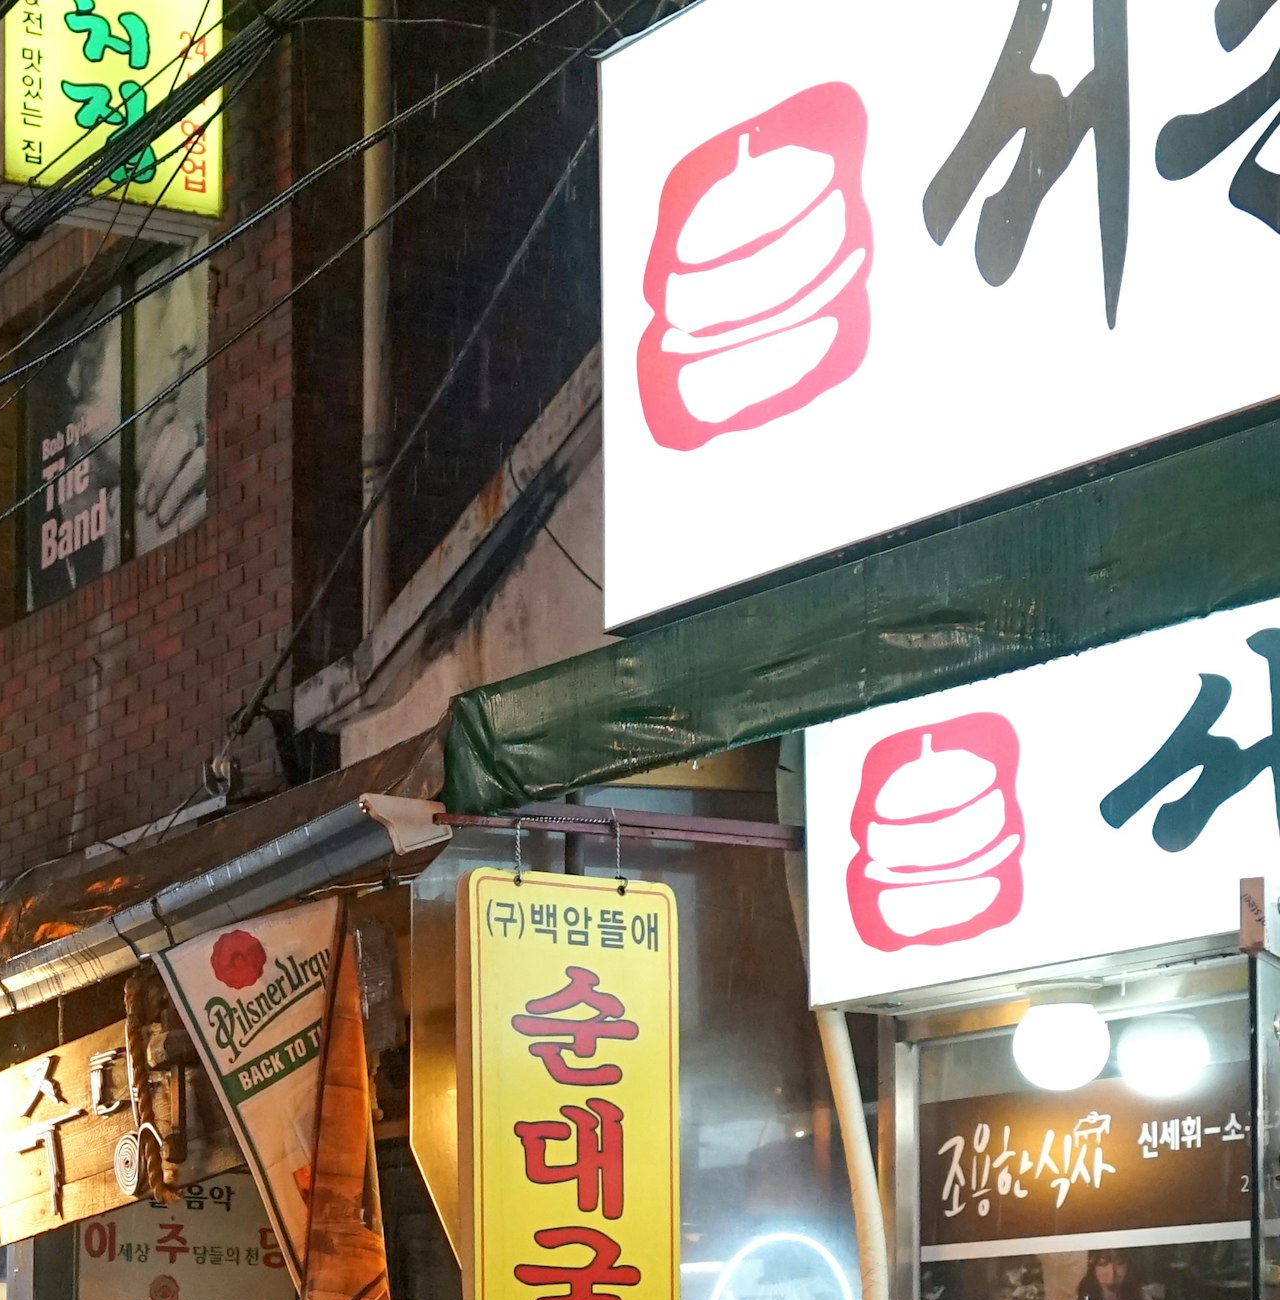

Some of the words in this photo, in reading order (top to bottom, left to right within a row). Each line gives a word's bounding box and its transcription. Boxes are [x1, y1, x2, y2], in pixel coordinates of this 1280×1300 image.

[21, 140, 43, 165] 집
[42, 431, 64, 462] Bob
[42, 456, 90, 513] The
[41, 487, 107, 571] Band
[203, 972, 289, 1065] Pilsner
[238, 1051, 287, 1092] BACK
[285, 1037, 308, 1063] TO
[183, 1183, 236, 1212] 음악
[84, 1221, 151, 1263] 이세상
[155, 1217, 241, 1266] 주당들의
